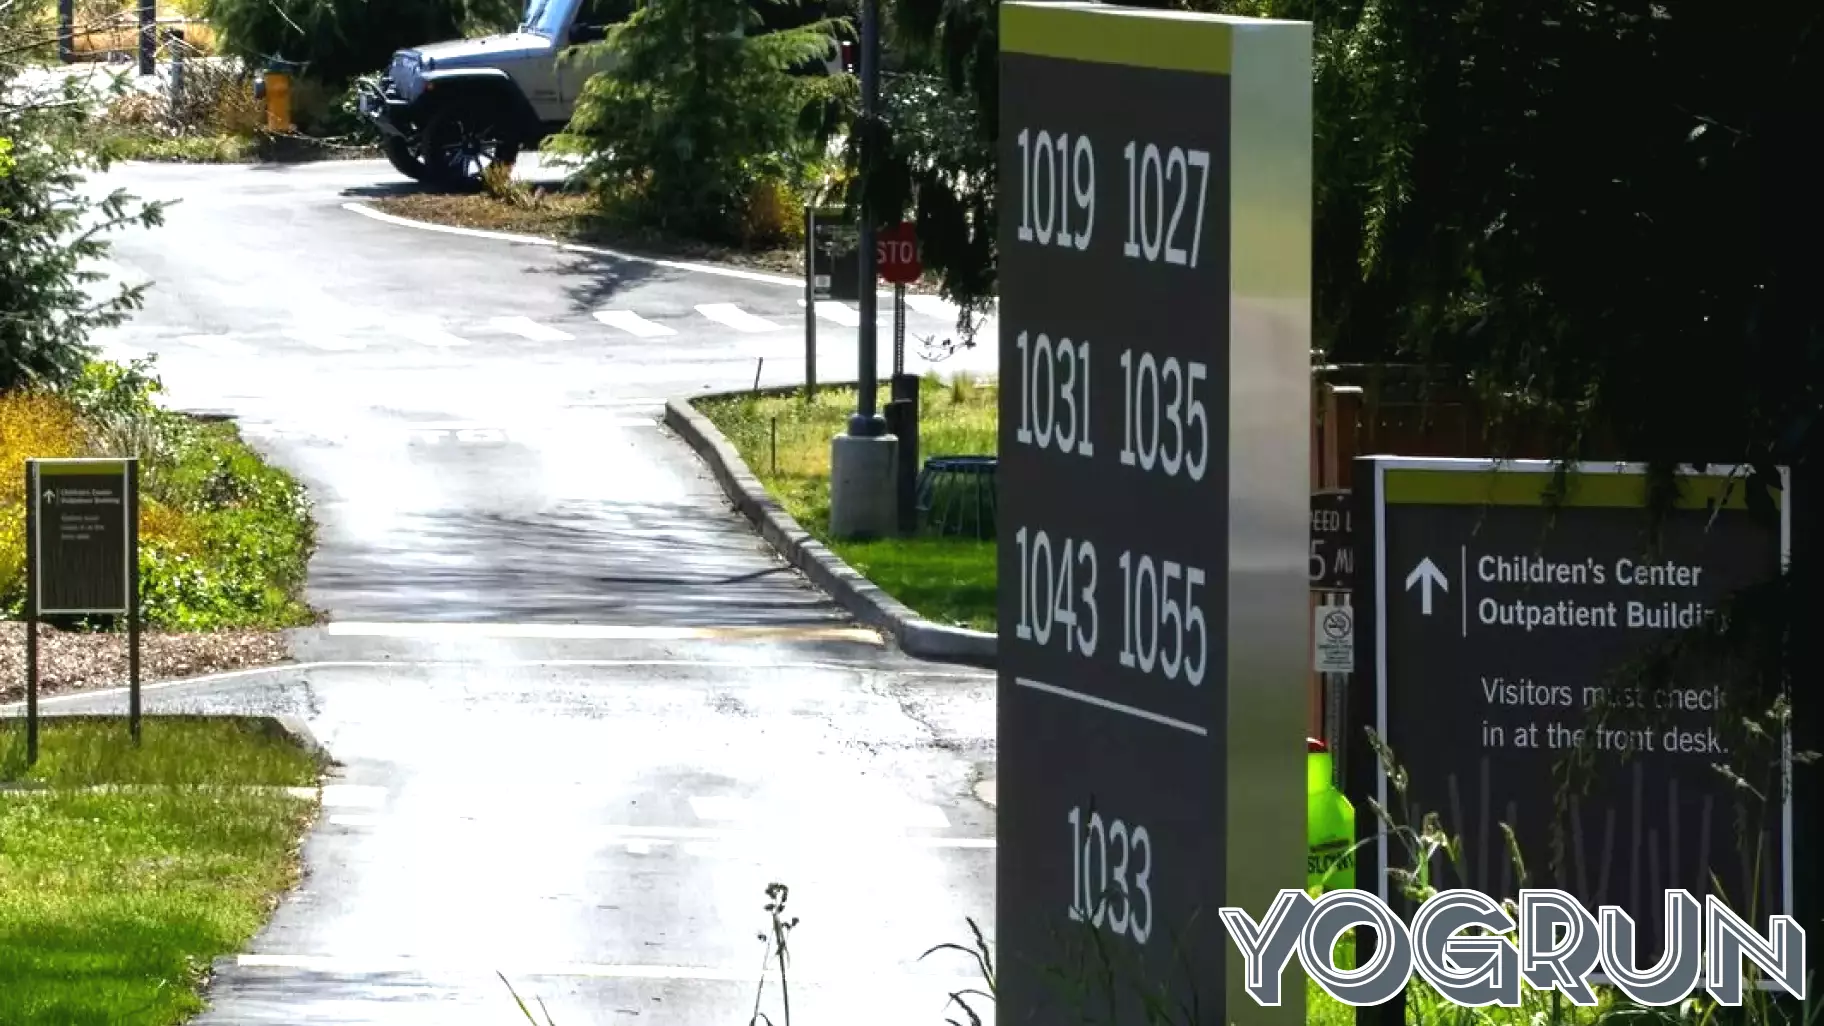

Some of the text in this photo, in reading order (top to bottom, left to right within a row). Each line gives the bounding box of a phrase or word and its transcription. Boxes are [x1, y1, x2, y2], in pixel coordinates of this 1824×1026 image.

[1017, 127, 1210, 269] 1019 1027
[1016, 330, 1208, 481] 1031 1035
[1309, 508, 1340, 532] EED
[1478, 555, 1702, 587] Children's Center
[1015, 526, 1207, 687] 1043 1055
[1478, 598, 1617, 631] Outpatient
[1480, 676, 1573, 707] Visitors
[1482, 720, 1729, 754] in at the front desk.
[1067, 805, 1153, 945] 1033
